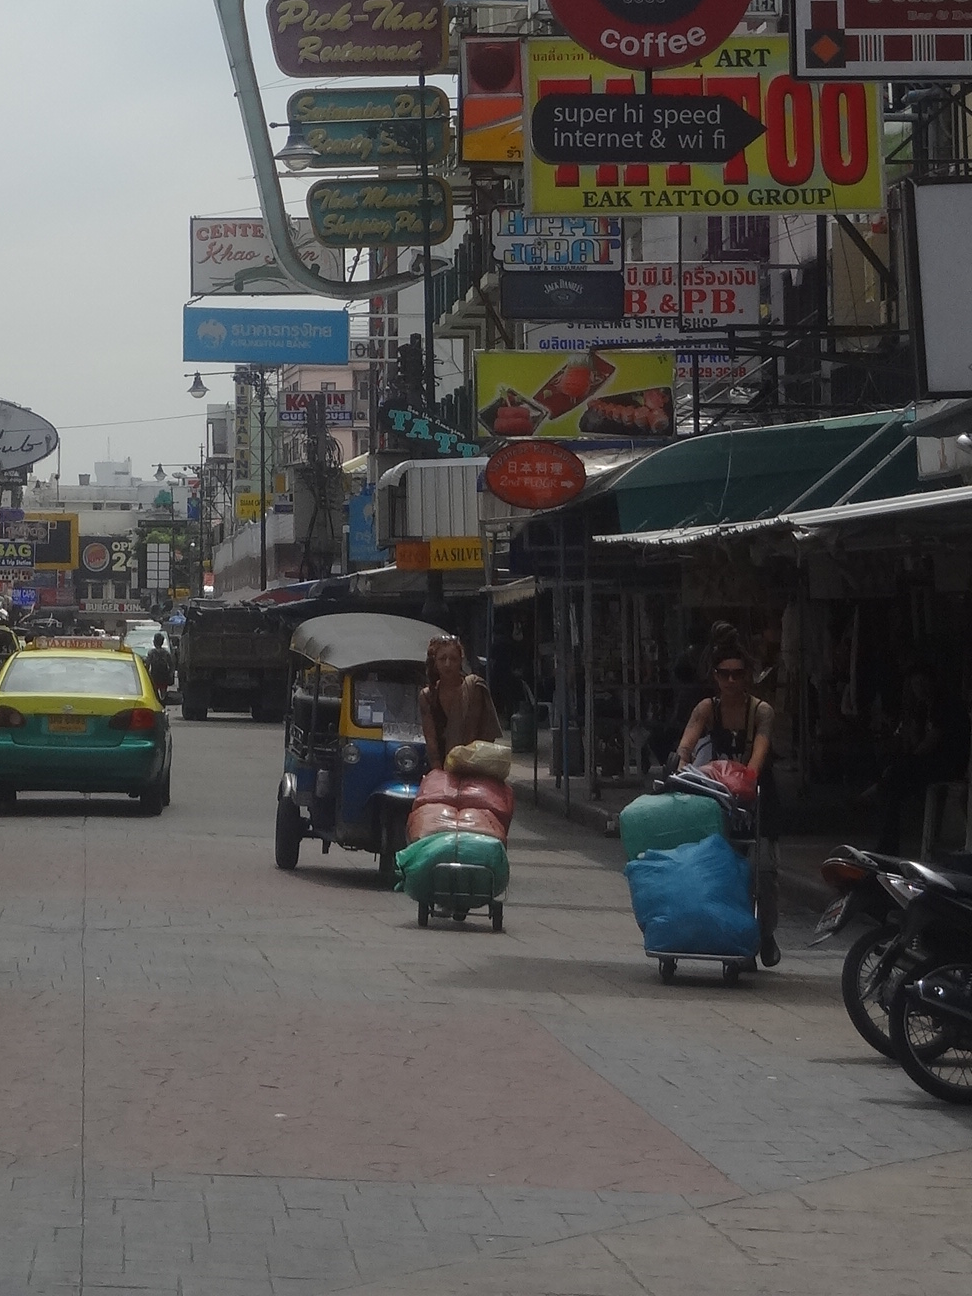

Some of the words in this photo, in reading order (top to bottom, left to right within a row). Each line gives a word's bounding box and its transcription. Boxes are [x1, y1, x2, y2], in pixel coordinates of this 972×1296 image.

[297, 35, 424, 64] Restaurant
[599, 26, 707, 58] coffee
[715, 48, 771, 68] ART
[553, 104, 618, 127] super
[624, 103, 644, 124] hi
[653, 104, 721, 130] speed
[553, 127, 644, 149] internet
[649, 129, 666, 149] &
[678, 129, 704, 150] wi
[712, 128, 726, 150] fi
[583, 190, 638, 209] EAK
[640, 189, 739, 208] TATTOO
[747, 188, 832, 206] GROUP
[196, 222, 268, 242] CENTE
[323, 213, 394, 240] Shopping
[197, 241, 262, 265] Khao
[659, 295, 679, 314] &
[567, 317, 631, 330] STERLING
[635, 317, 679, 330] SILVER
[684, 317, 719, 330] SHOP
[286, 338, 312, 349] BANK
[236, 366, 249, 445] OIENTAL
[435, 418, 466, 440] Amazing
[508, 461, 563, 475] 日本料理
[499, 474, 520, 487] 2nd
[434, 548, 449, 562] AA
[450, 548, 485, 562] SILVE
[85, 603, 120, 612] BURGER
